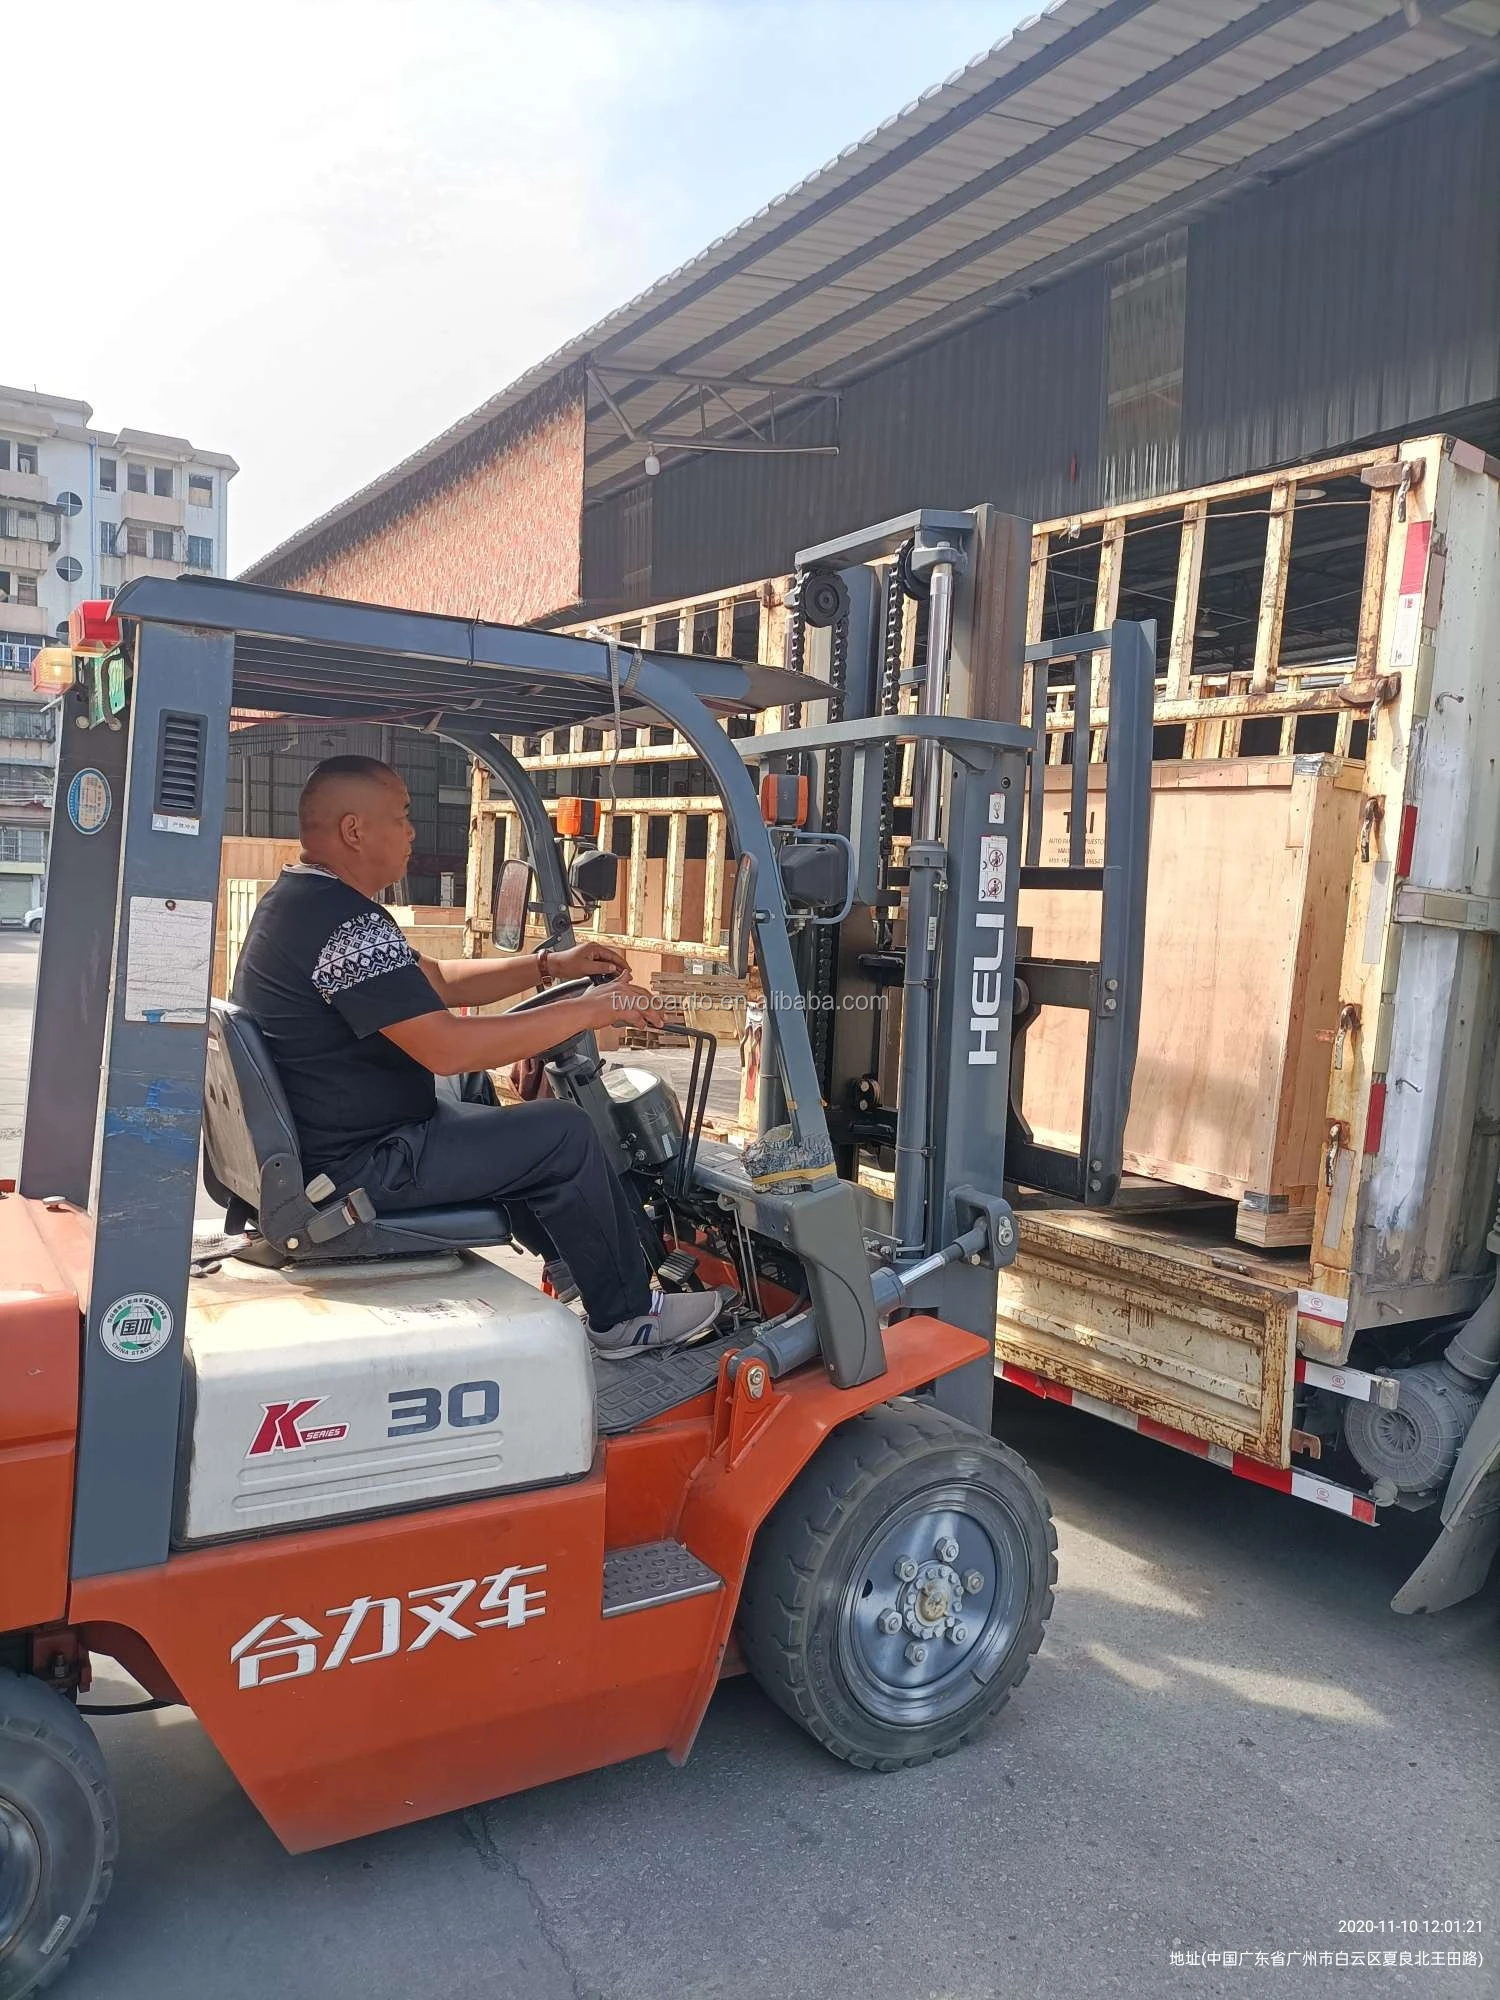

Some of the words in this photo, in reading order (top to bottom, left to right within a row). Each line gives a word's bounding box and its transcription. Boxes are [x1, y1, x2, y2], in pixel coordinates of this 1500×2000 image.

[1063, 811, 1095, 834] TI
[968, 913, 1005, 1065] HELI
[112, 1342, 129, 1355] CHINA
[131, 1345, 153, 1356] STAGE
[249, 1399, 323, 1455] K
[306, 1428, 341, 1440] SERIES
[387, 1380, 500, 1438] 30
[231, 1564, 547, 1690] 合力叉车
